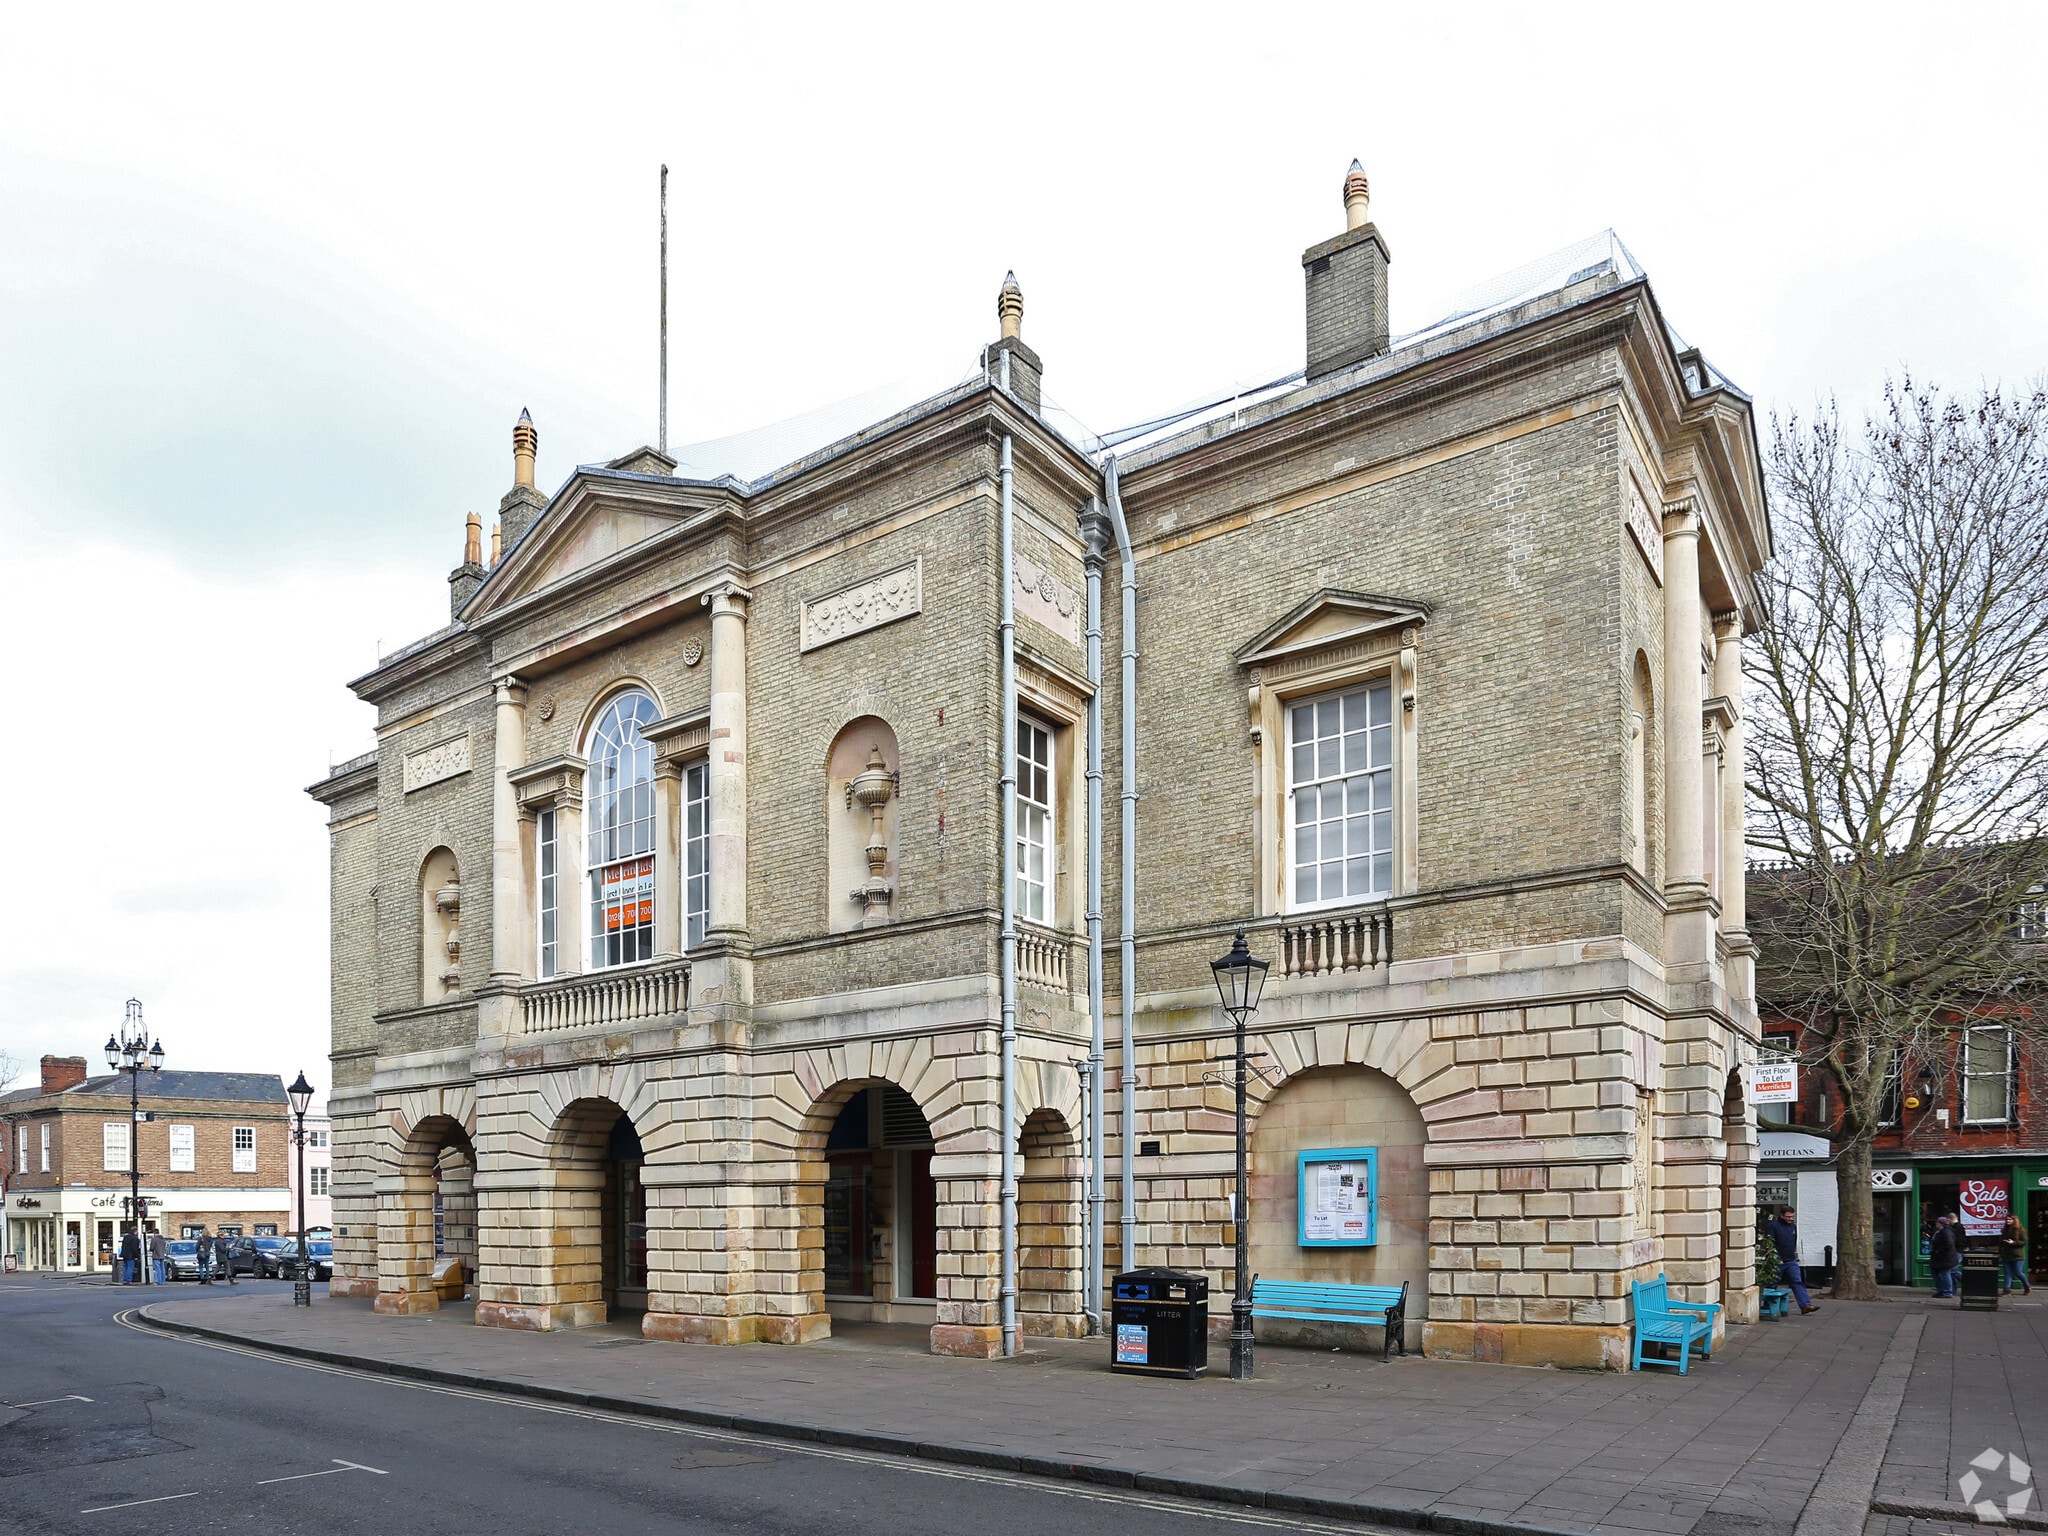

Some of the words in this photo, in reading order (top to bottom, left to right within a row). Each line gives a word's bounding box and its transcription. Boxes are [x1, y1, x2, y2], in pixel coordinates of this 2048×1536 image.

[1773, 1067, 1791, 1075] Floor
[1757, 1083, 1790, 1091] Merrifields
[1764, 1148, 1815, 1156] OPTICIANS
[1960, 1180, 2008, 1207] Sale
[91, 1193, 116, 1207] Café
